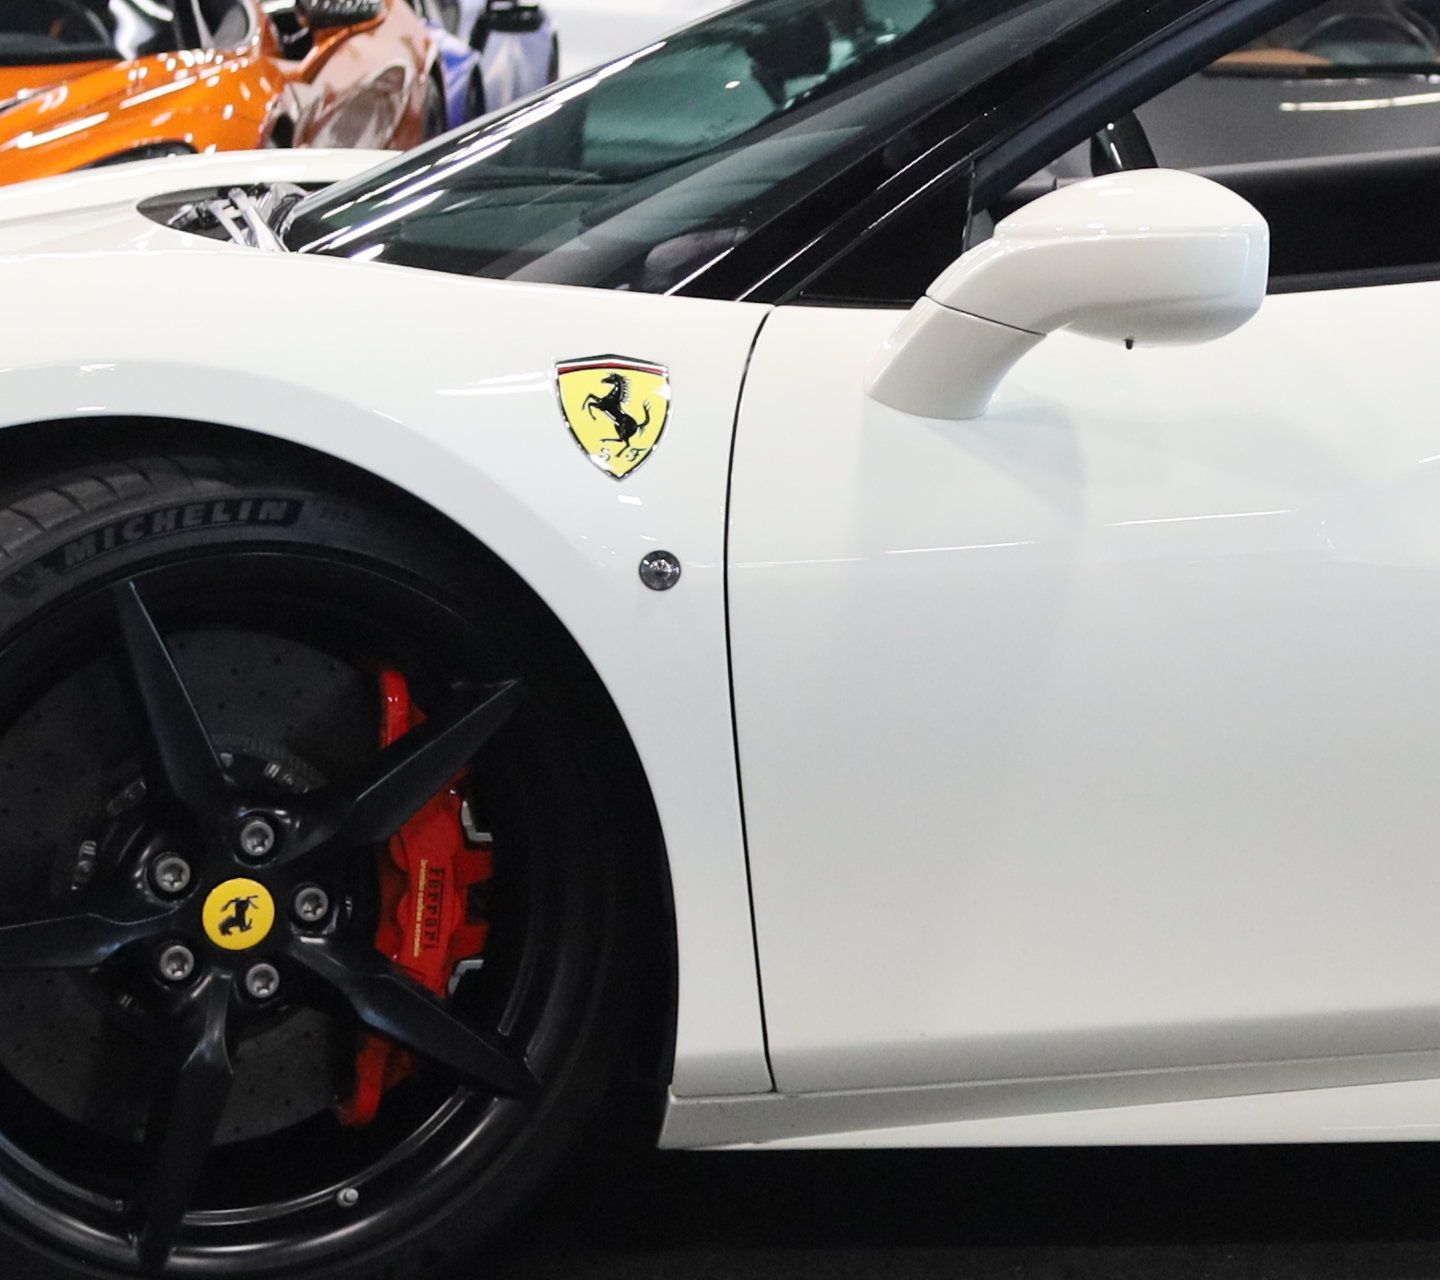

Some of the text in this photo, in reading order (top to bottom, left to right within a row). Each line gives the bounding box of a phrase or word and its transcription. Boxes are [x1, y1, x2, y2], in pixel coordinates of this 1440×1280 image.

[599, 446, 647, 462] S F
[63, 498, 290, 569] MICHELIN
[423, 865, 445, 950] Ferrari
